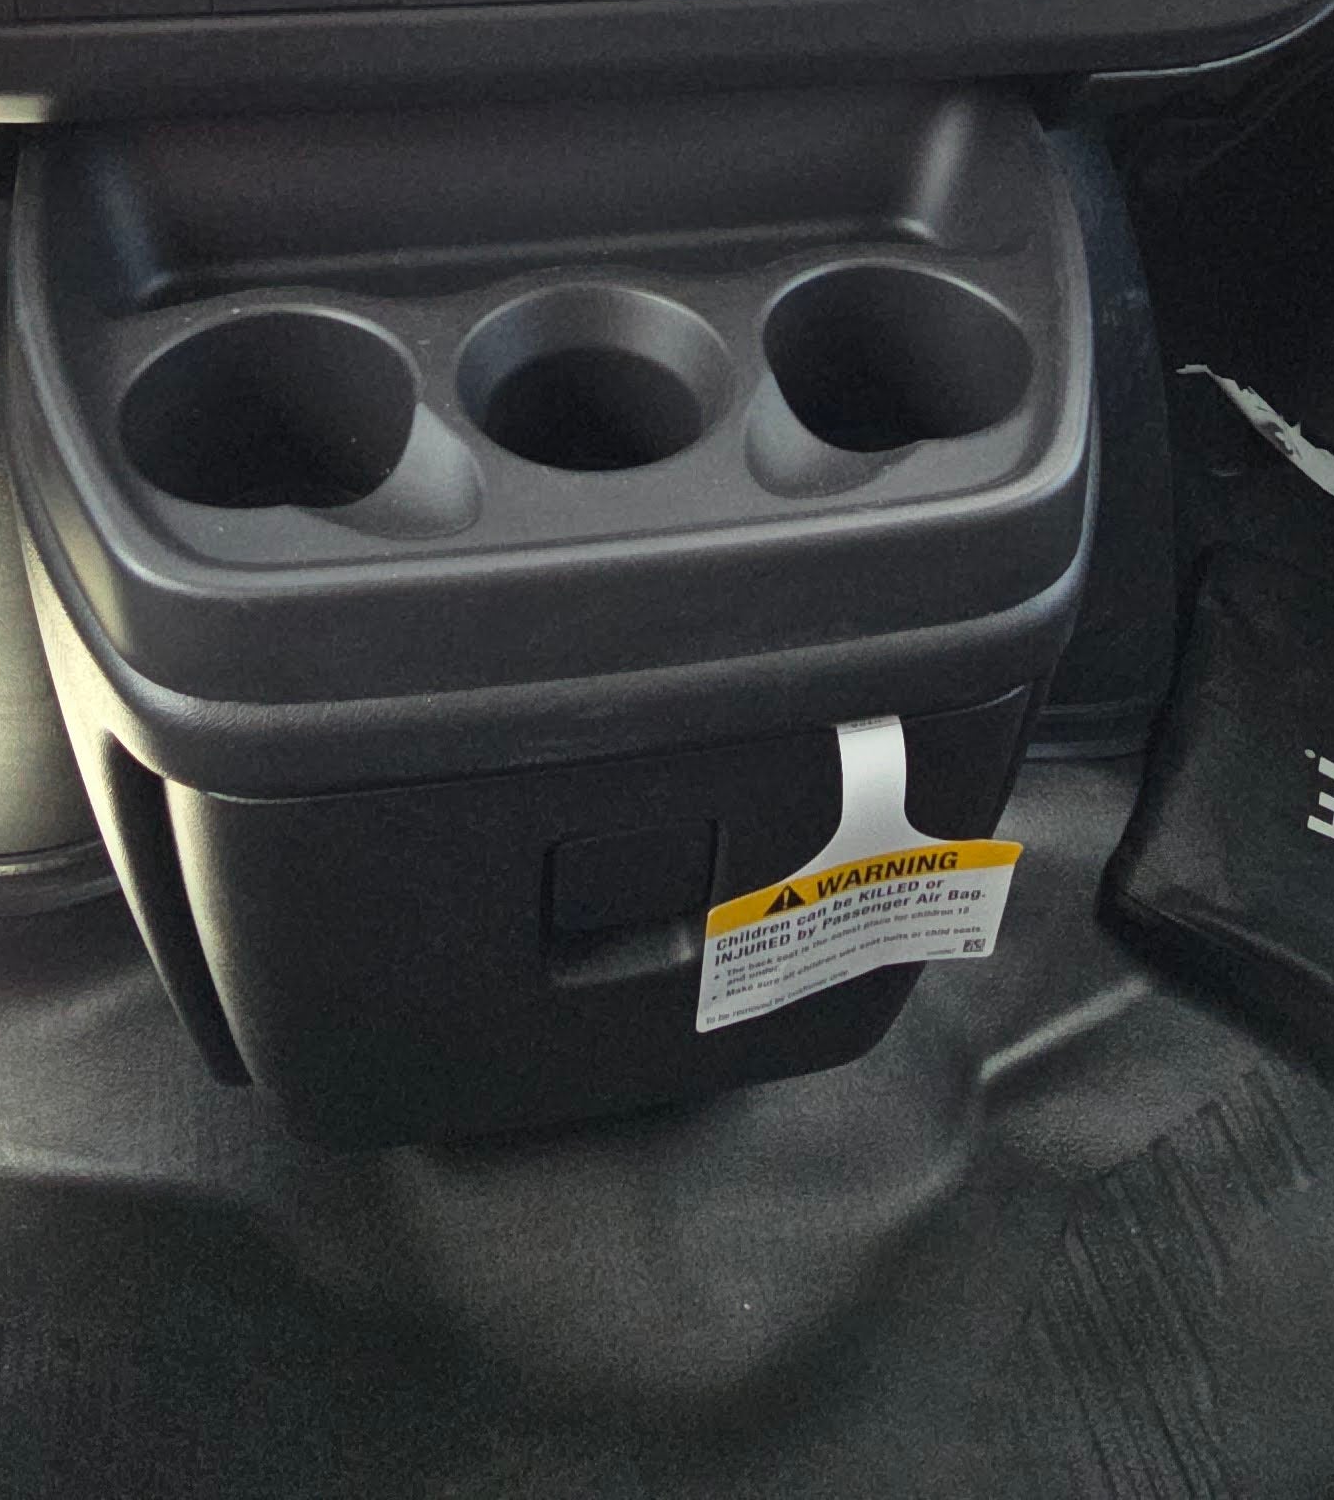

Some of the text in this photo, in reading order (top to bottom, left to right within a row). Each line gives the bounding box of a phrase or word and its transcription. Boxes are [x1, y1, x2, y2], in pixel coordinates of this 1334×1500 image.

[817, 851, 959, 899] WARNING
[715, 889, 987, 966] INJURED by Passenger Air Bag.
[716, 879, 945, 952] Children can be KILLED or
